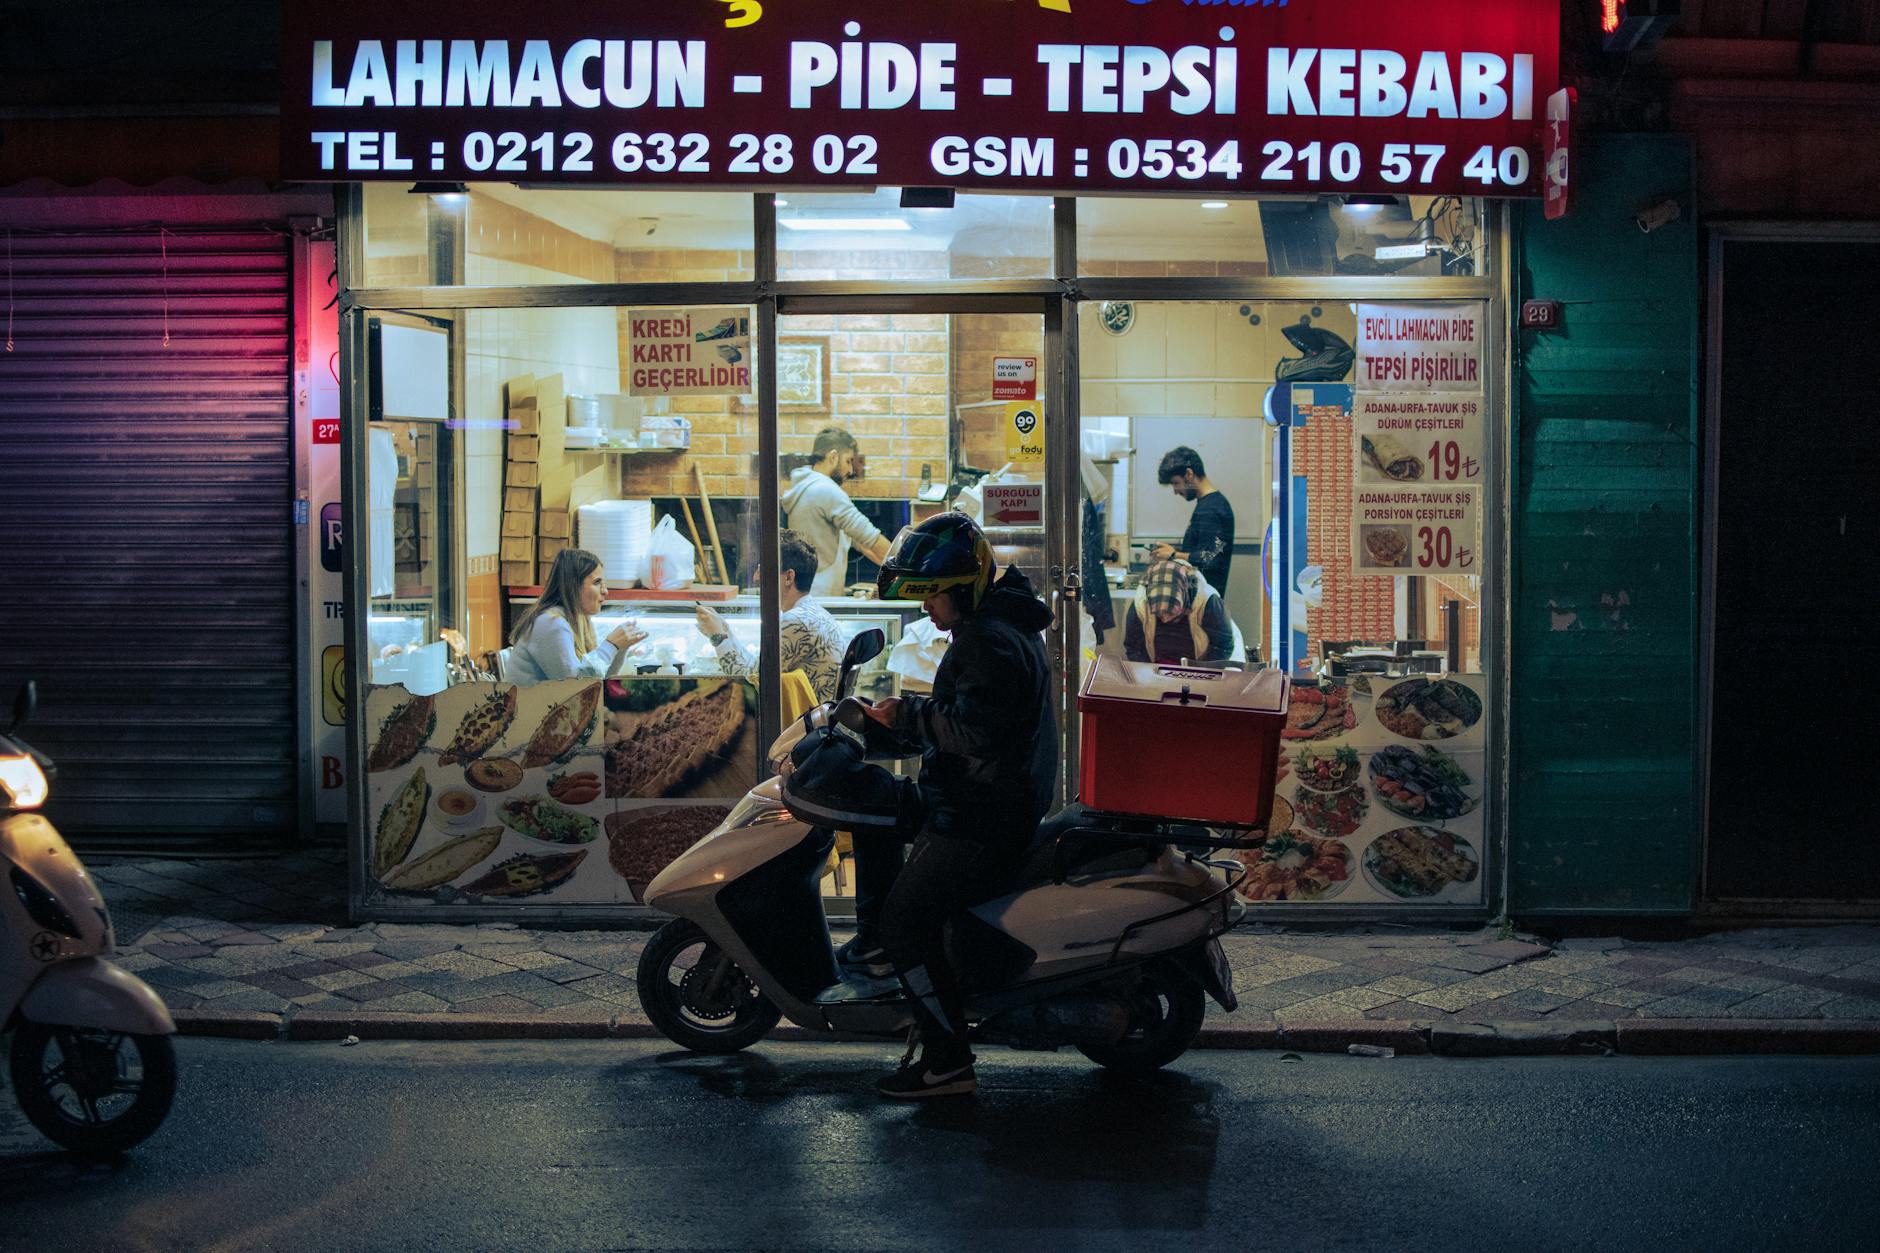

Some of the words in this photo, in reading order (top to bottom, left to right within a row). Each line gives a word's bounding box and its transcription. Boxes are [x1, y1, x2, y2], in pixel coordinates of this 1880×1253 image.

[312, 39, 706, 109] LAHMACUN
[790, 20, 956, 110] PİDE
[1037, 26, 1237, 115] TEPSİ
[1267, 48, 1533, 120] KEBABI
[311, 131, 413, 170] TEL
[463, 131, 594, 172] 0212
[611, 132, 710, 173] 632
[727, 133, 794, 174] 28
[812, 134, 878, 174] 02
[930, 135, 1054, 177] GSM
[1107, 138, 1243, 180] 0534
[1260, 140, 1361, 182] 210
[1379, 143, 1446, 183] 57
[1463, 145, 1528, 185] 40
[1528, 306, 1548, 322] 29
[632, 314, 691, 338] KREDİ
[1366, 314, 1393, 341] EVCİL
[1396, 318, 1449, 342] LAHMACUN
[1452, 314, 1474, 342] PİDE
[633, 343, 691, 363] KARTI
[633, 363, 749, 392] GEÇERLİDİR
[1365, 351, 1407, 380] TEPSİ
[1411, 352, 1477, 387] PİŞİRİLİR
[994, 386, 1027, 395] zomato
[1364, 402, 1459, 414] ADANA-URFA-TAVUK
[1462, 402, 1477, 415] ŞİŞ
[1016, 415, 1035, 428] go
[1377, 417, 1412, 430] DÜRÜM
[1415, 417, 1464, 431] ÇEŞİTLERİ
[986, 487, 1040, 498] SÜRGÜLÜ
[1358, 493, 1453, 504] ADANA-URFA-TAVUK
[1455, 490, 1471, 506] ŞİŞ
[1000, 499, 1028, 507] KAPI
[1364, 506, 1413, 520] PORSİYON
[1415, 505, 1465, 522] ÇEŞİTLERİ
